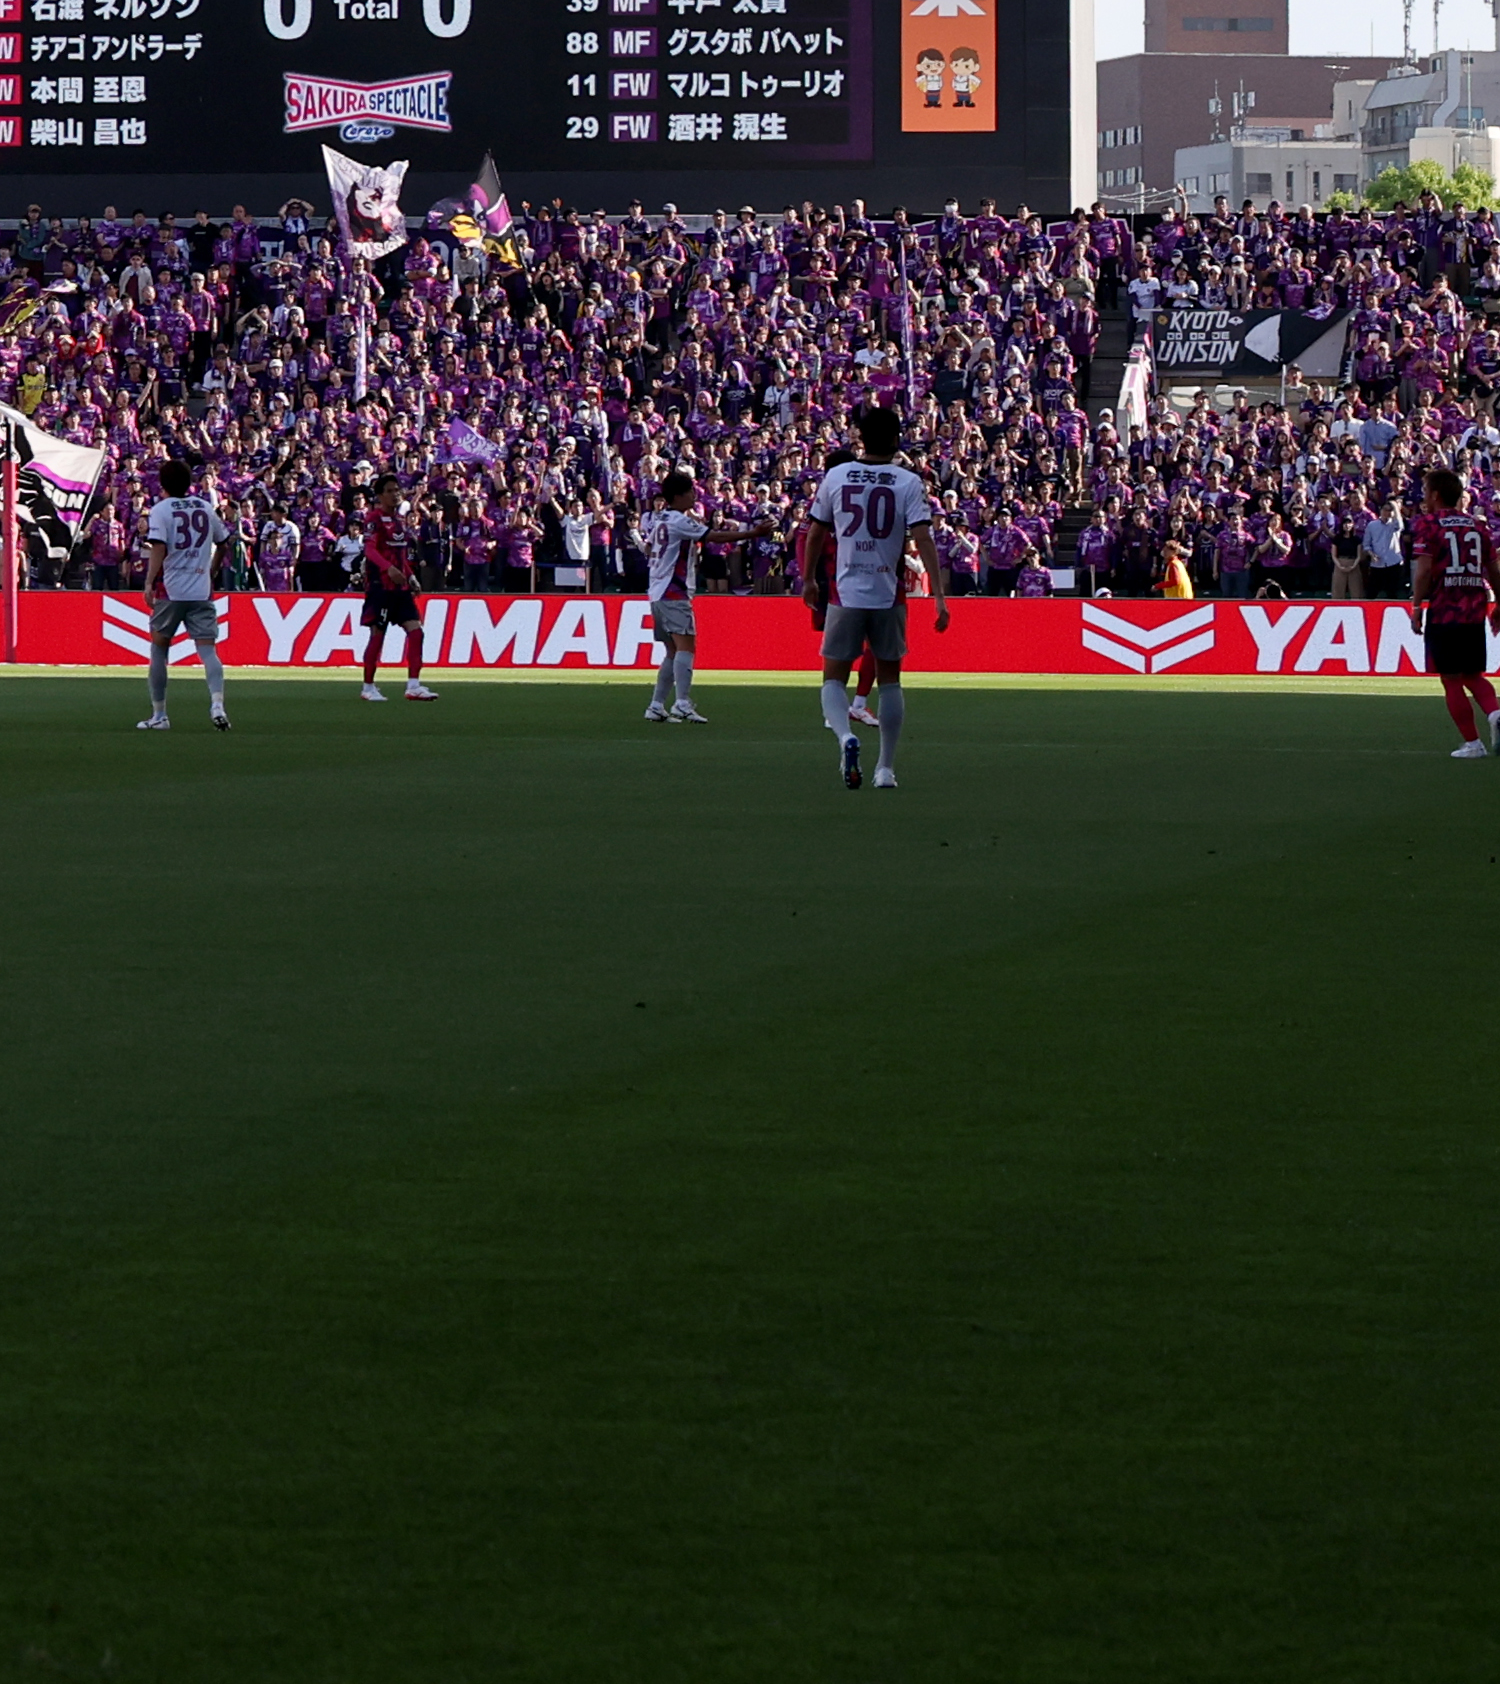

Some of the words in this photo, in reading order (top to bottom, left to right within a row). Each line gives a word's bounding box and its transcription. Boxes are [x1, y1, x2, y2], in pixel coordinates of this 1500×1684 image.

[30, 33, 86, 62] チアゴ
[91, 33, 203, 61] アンドラーデ
[566, 31, 599, 55] 88
[613, 30, 651, 55] MF
[667, 27, 753, 56] グスタボ
[30, 76, 84, 104] 本間
[93, 75, 147, 103] 至恩
[567, 73, 596, 97] 11
[613, 72, 651, 97] FW
[667, 72, 730, 99] マルコ
[741, 69, 845, 98] トゥーリオ
[287, 82, 366, 123] SAKURA
[369, 81, 447, 122] SPECTACLE
[30, 117, 84, 146] 柴山
[93, 117, 147, 146] 昌也
[343, 124, 392, 140] Cerezo
[566, 116, 599, 139] 29
[613, 114, 651, 139] FW
[667, 112, 723, 142] 酒井
[1170, 311, 1229, 333] KYOTO
[1157, 340, 1239, 366] UNISON
[841, 485, 896, 539] 50
[172, 509, 209, 550] 39
[1444, 531, 1482, 574] 13
[380, 608, 388, 622] 4
